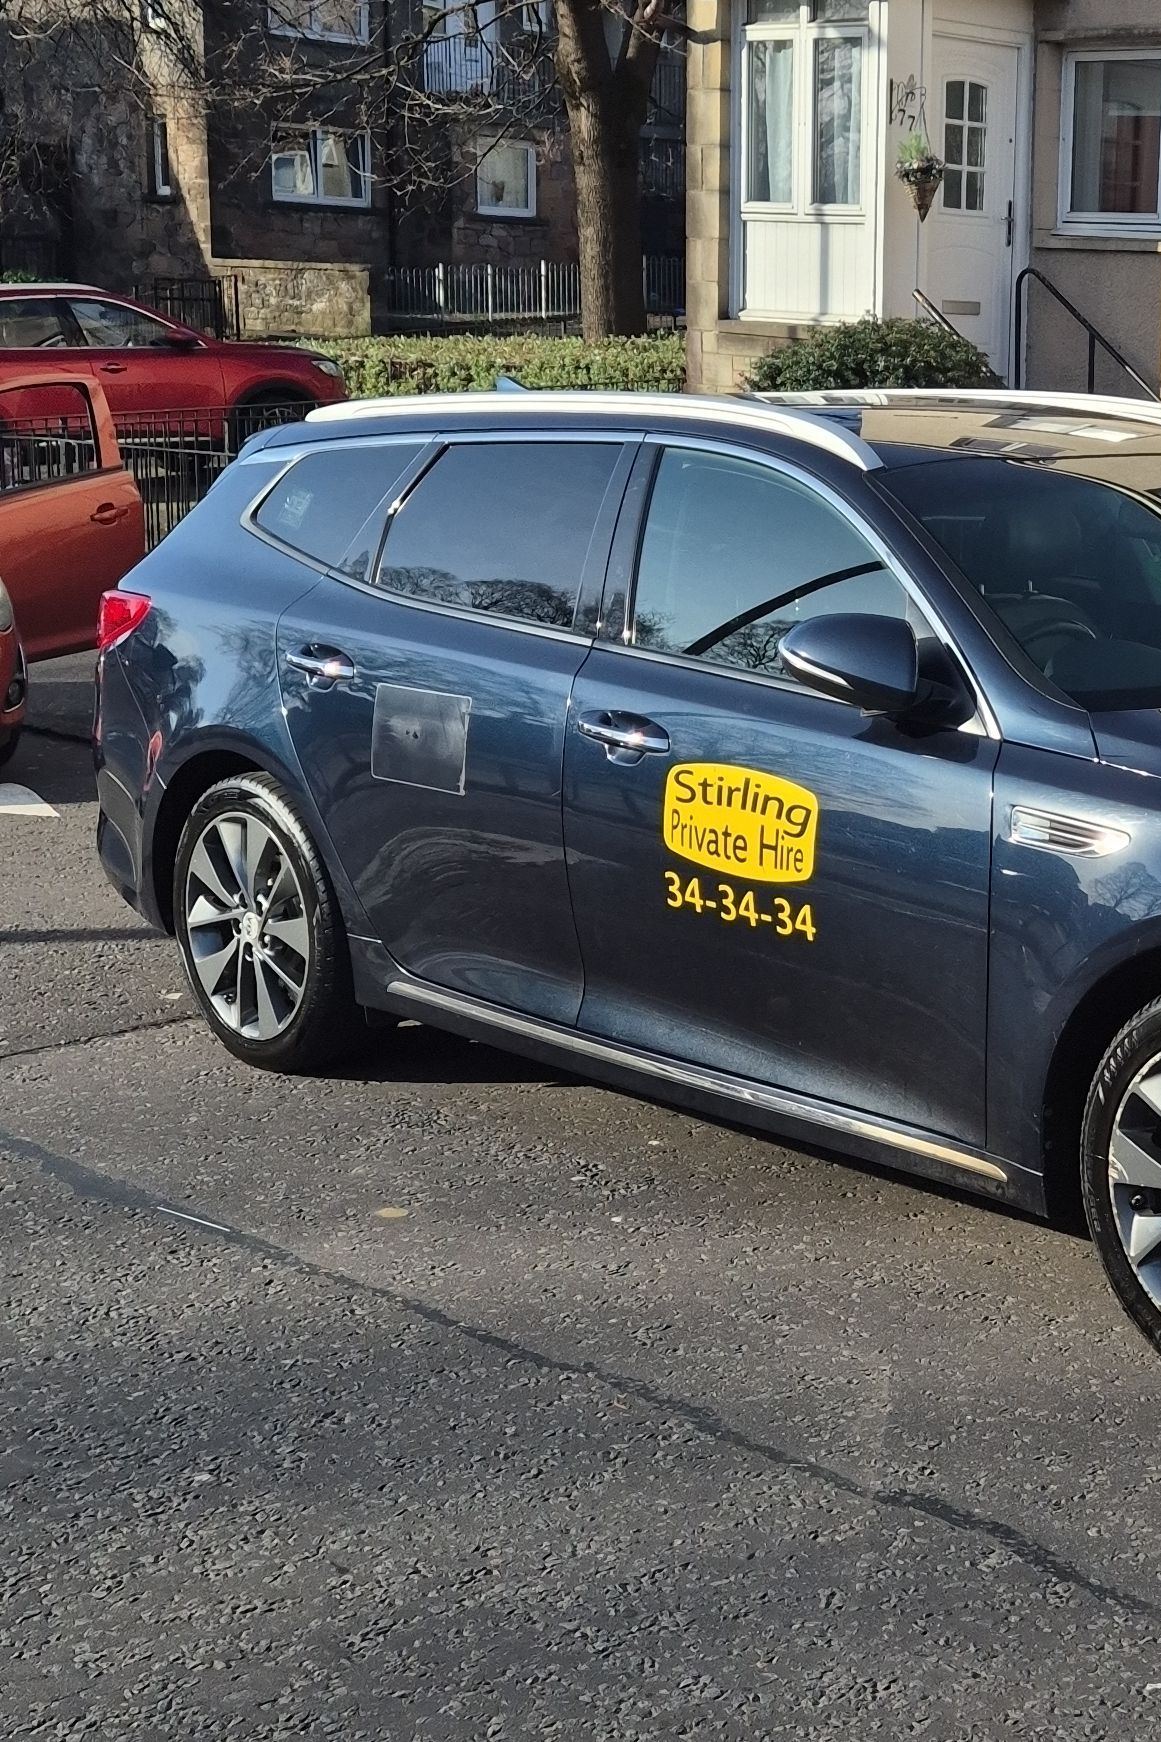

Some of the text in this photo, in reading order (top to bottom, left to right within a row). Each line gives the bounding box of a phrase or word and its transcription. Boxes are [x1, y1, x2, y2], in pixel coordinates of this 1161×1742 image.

[897, 108, 916, 131] 77
[673, 769, 812, 838] Stirling
[671, 808, 804, 873] Private Hire
[664, 870, 817, 941] 34-34-34
